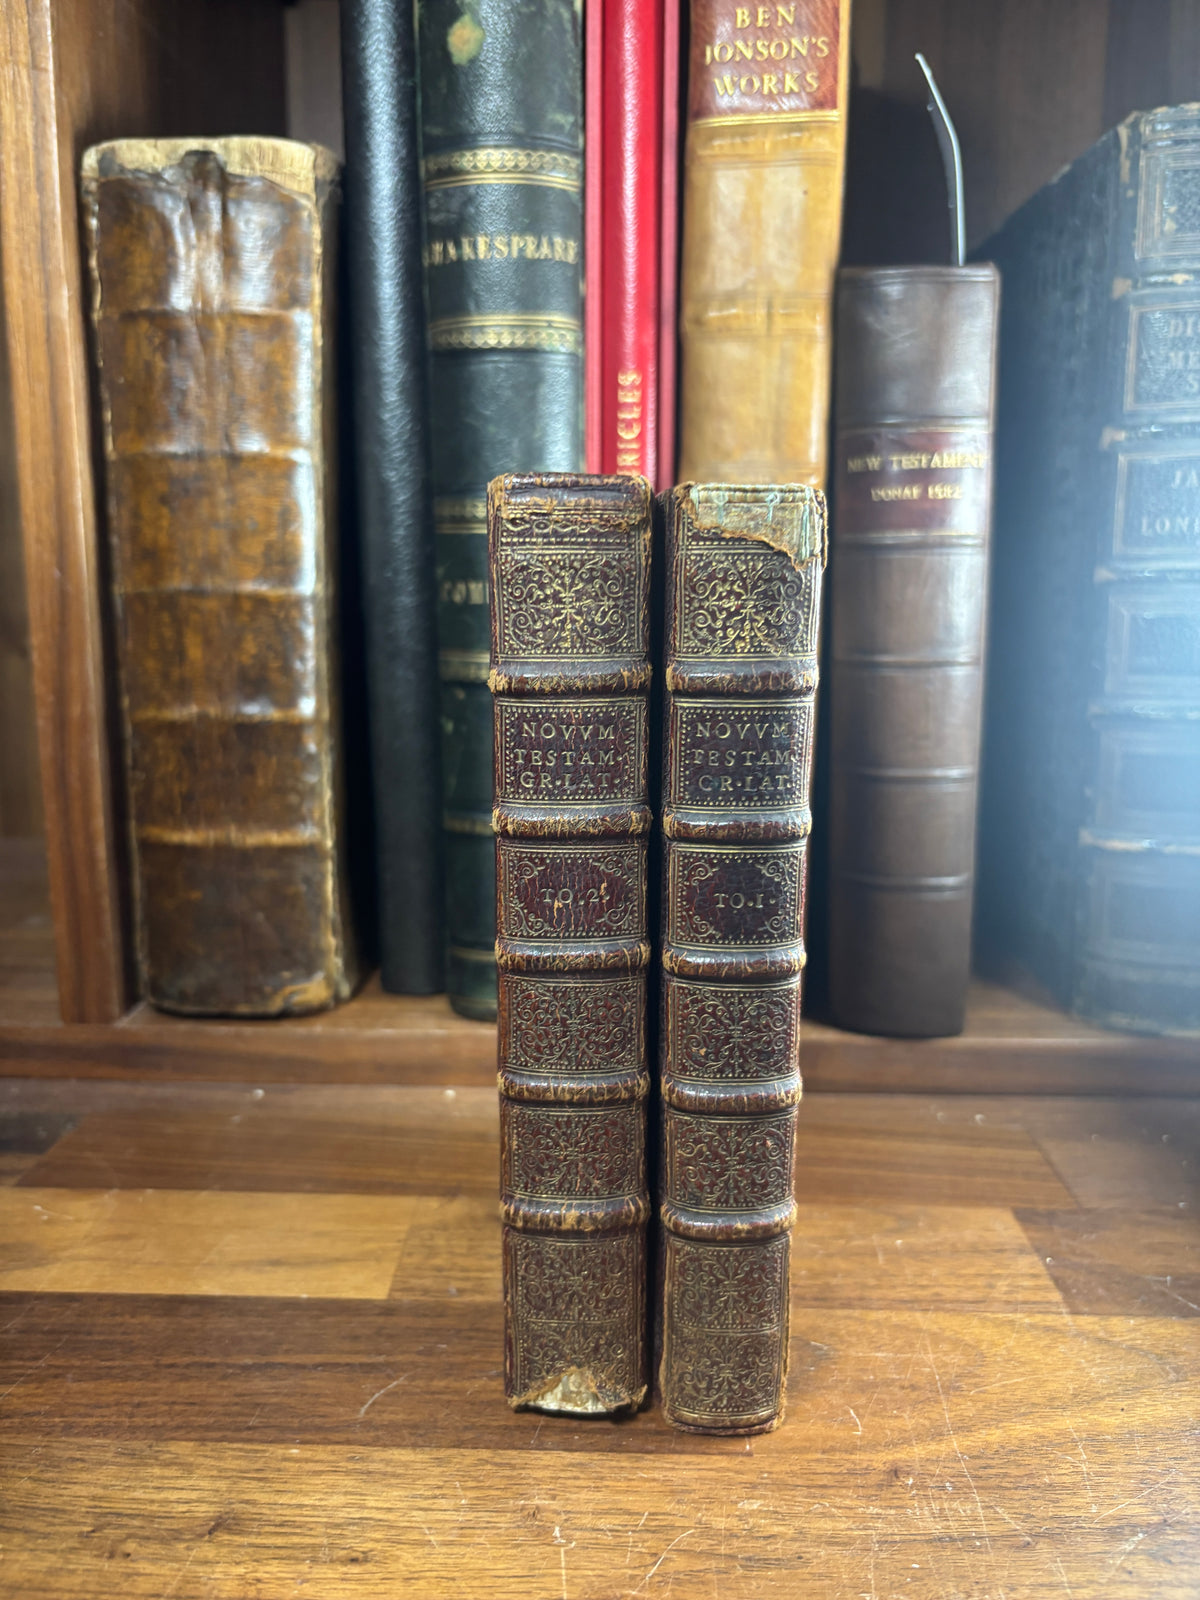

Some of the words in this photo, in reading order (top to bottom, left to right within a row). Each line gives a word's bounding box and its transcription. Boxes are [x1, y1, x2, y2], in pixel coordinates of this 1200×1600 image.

[735, 4, 795, 28] BEN
[704, 36, 829, 66] JONSON'S
[713, 71, 820, 96] WORKS
[421, 232, 579, 267] HAKESPEARE
[846, 453, 881, 473] NEW
[888, 450, 986, 470] TESTAMENT
[521, 722, 615, 740] NOVVM
[695, 721, 791, 739] NOVVM
